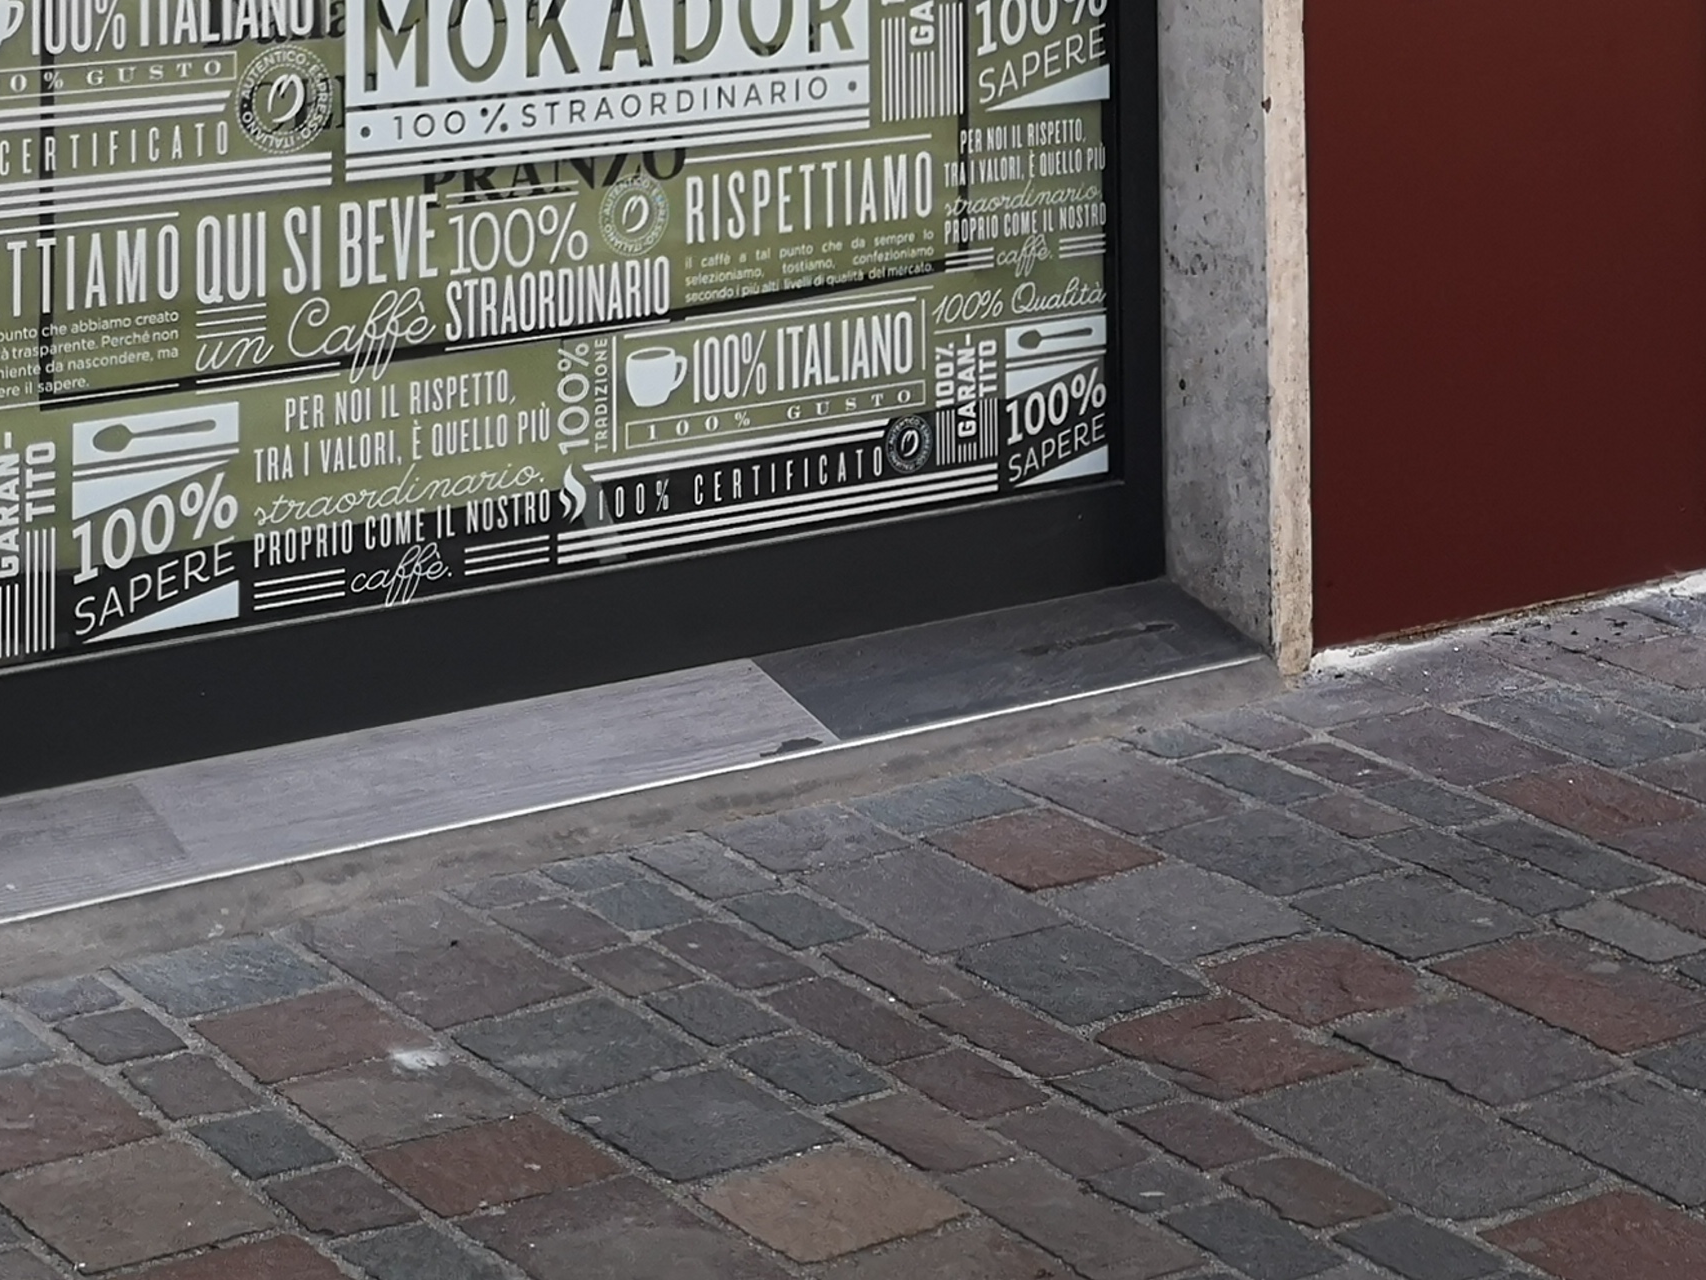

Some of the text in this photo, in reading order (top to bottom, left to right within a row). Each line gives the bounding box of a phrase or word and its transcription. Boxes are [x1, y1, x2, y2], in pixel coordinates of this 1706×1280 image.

[86, 59, 222, 87] GUSTO
[242, 50, 306, 99] AUTENTICO
[978, 24, 1107, 104] SAPERE
[393, 102, 509, 140] 100%
[521, 76, 829, 130] STRAORDINARIO
[686, 150, 933, 245] RISPETTIAMO
[196, 193, 438, 305] QUI SI BEVE
[448, 201, 589, 275] 100%
[41, 324, 67, 339] che
[71, 316, 131, 335] abbiamo
[135, 311, 179, 327] creato
[196, 287, 437, 383] un Caffè
[445, 254, 670, 342] STRAORDINARIO
[932, 276, 1107, 324] 100% Qualità
[101, 331, 149, 349] Perché
[153, 329, 179, 341] non
[693, 311, 913, 403] 100% ITALIANO
[936, 339, 955, 409] 100%
[979, 339, 998, 398] TITO
[285, 368, 516, 432] PER NOI IL RISPETTO,
[557, 341, 590, 456] 100%
[594, 337, 609, 453] TRADIZIONE
[647, 388, 912, 442] 100% GUSTO
[957, 333, 977, 439] GARAN-
[1005, 367, 1107, 445] 100%
[26, 441, 56, 523] TITO
[254, 402, 550, 484] TRA I VALORI, È QUELLO PIÙ
[1008, 413, 1106, 483] SAPERE
[598, 478, 670, 521] 100%
[694, 445, 884, 507] CERTIFICATO
[72, 471, 239, 585] 100%
[254, 489, 551, 568] PROPRIO COME IL NOSTRO
[74, 536, 235, 637] SAPERE
[351, 542, 453, 608] caffè.
